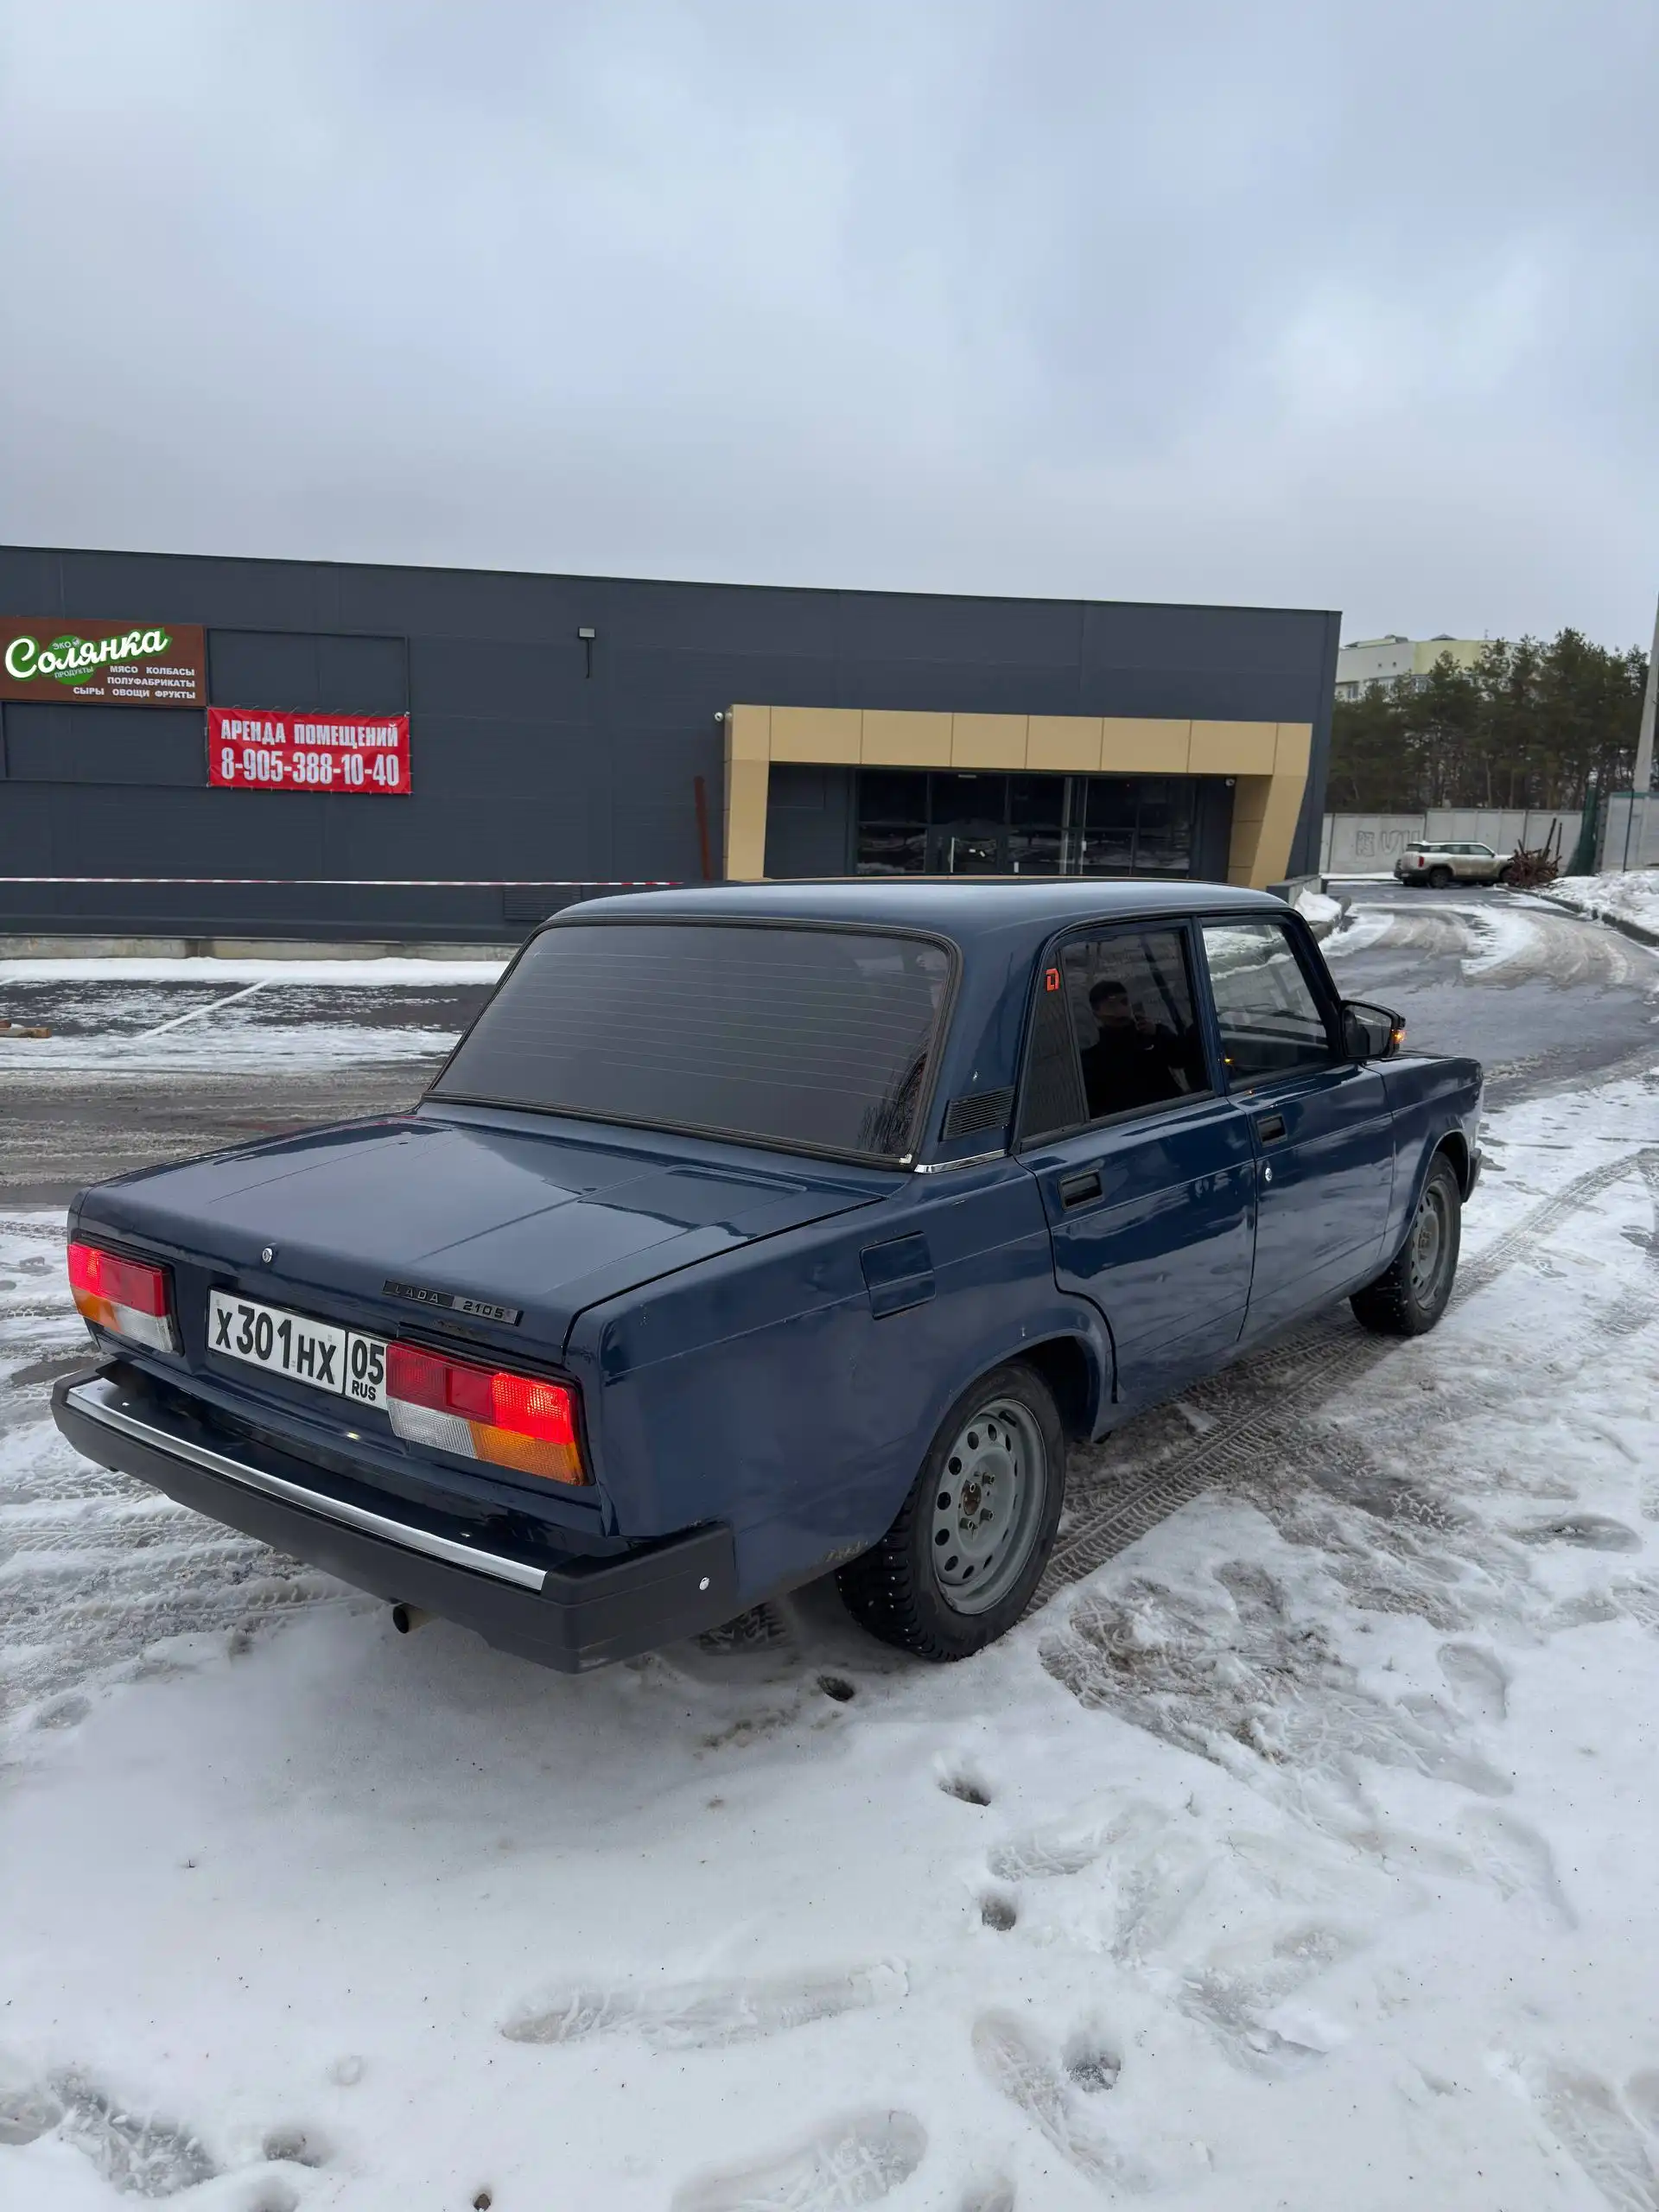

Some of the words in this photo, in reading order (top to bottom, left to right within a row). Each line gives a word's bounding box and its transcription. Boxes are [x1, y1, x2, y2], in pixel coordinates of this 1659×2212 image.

[5, 630, 168, 678] Солянка
[107, 677, 195, 688] ПОЛУФАБРИКАТЫ
[110, 665, 138, 674] МЯСО
[146, 666, 195, 677] КОЛБАСЫ
[73, 687, 105, 696] СЫРЫ
[112, 688, 149, 698] ОВОЩИ
[155, 690, 195, 699] ФРУКТЫ
[220, 719, 286, 746] АРЕНДА
[294, 723, 398, 749] ПОМЕЩЕНИЙ
[221, 747, 399, 787] 8-905-388-10-40
[395, 1285, 439, 1303] LADA
[463, 1300, 504, 1319] 2105
[352, 1339, 385, 1385] 05
[351, 1380, 376, 1402] RUS
